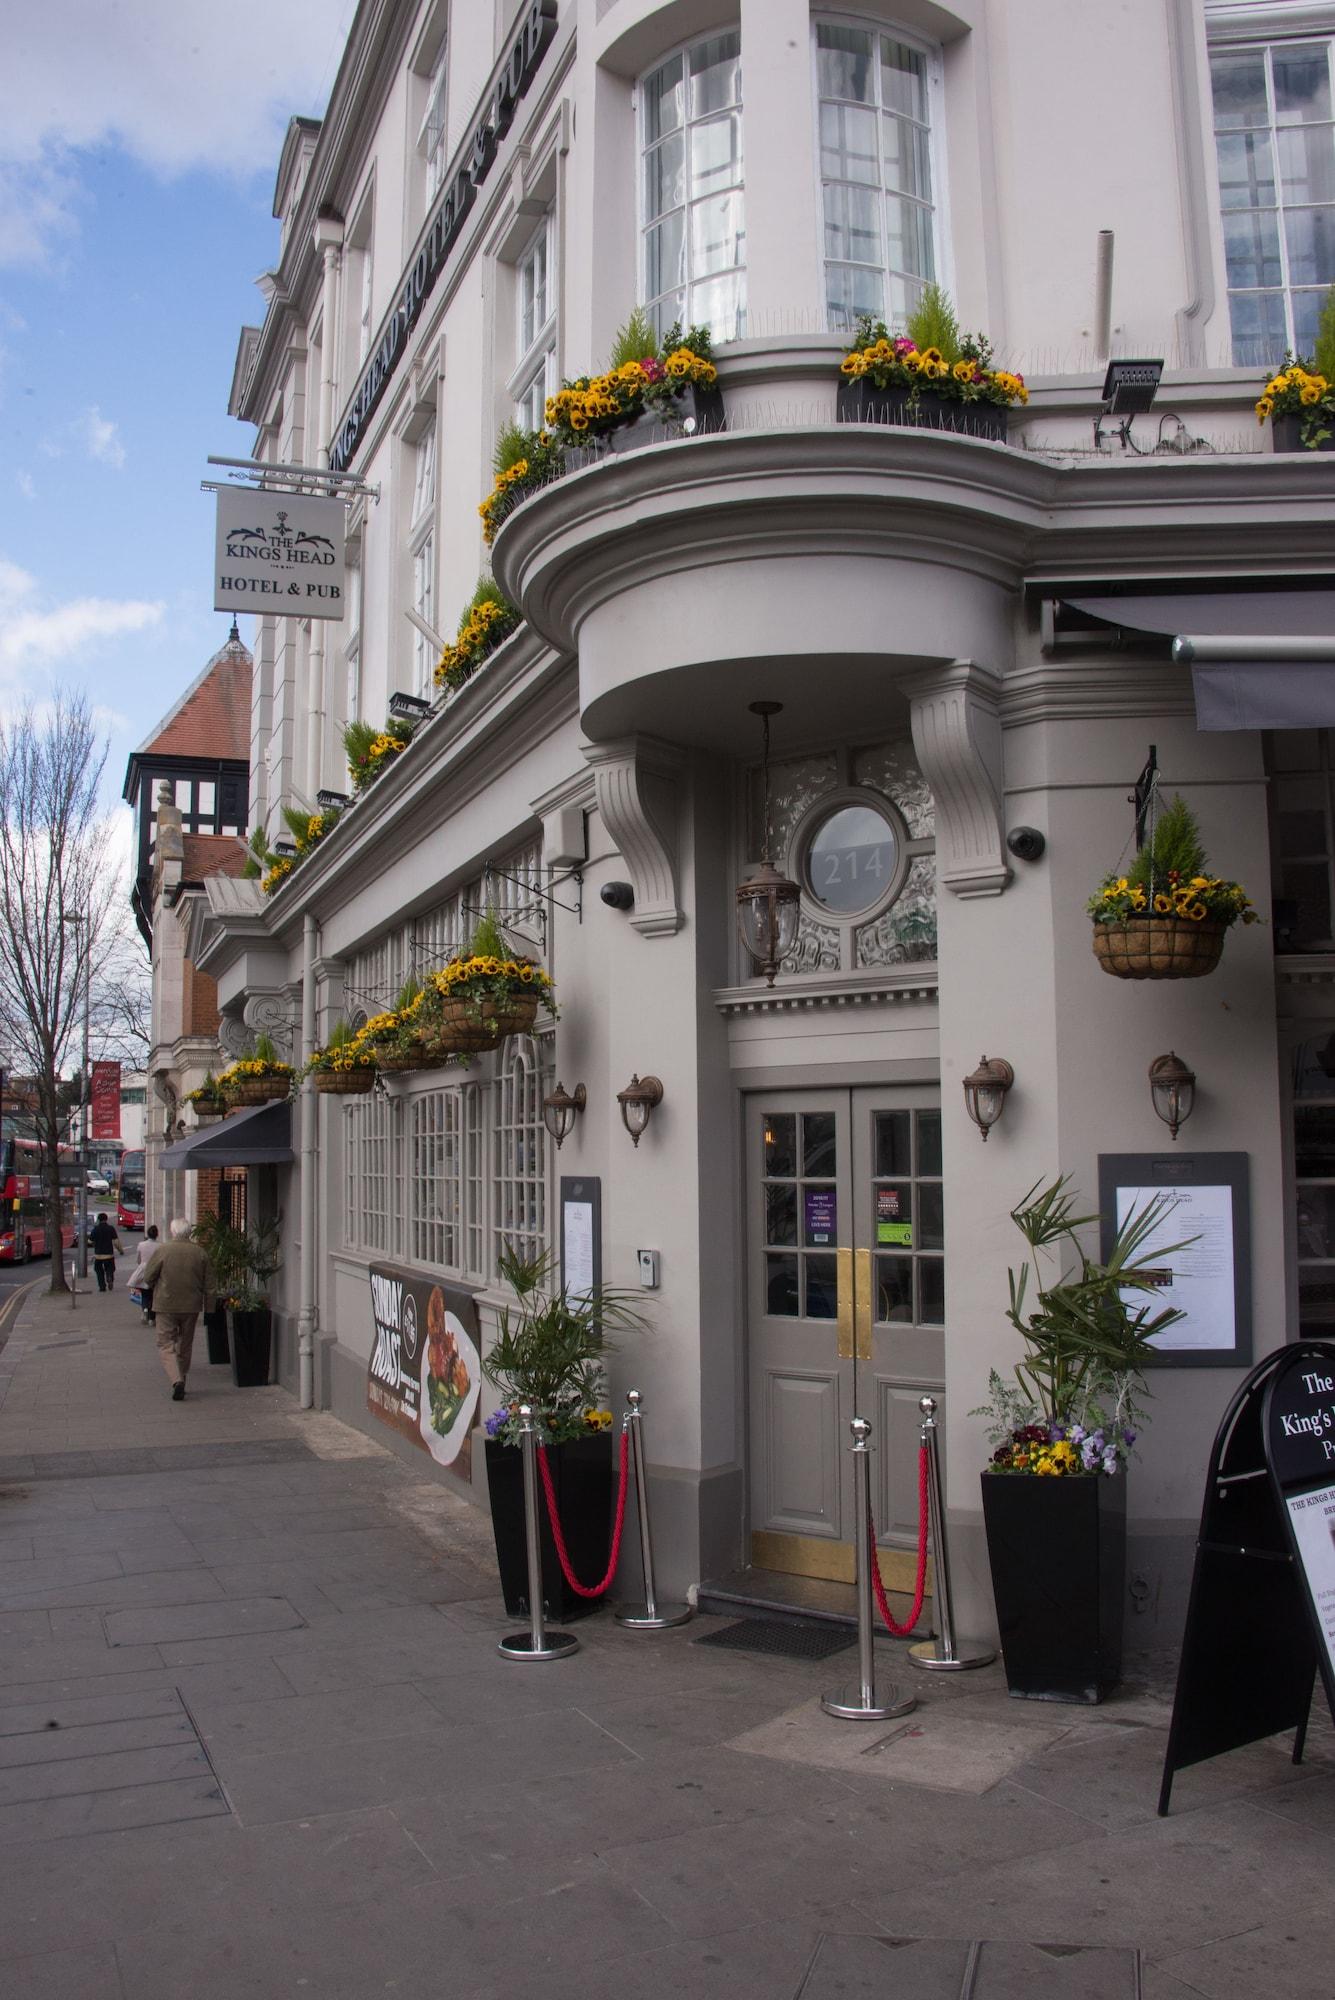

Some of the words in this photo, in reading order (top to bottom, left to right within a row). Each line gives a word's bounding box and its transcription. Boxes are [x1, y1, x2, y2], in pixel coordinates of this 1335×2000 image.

[360, 311, 399, 422] HEAD
[403, 171, 466, 333] HOTEL
[491, 0, 543, 138] PUB
[268, 536, 293, 549] THE
[226, 544, 281, 561] KINGS
[286, 549, 336, 566] HEAD
[220, 576, 283, 595] HOTEL
[287, 582, 301, 596] &
[306, 583, 341, 599] PUB
[824, 847, 883, 885] 214
[371, 1274, 403, 1331] SUNDAY
[1301, 1372, 1334, 1394] The
[1280, 1408, 1332, 1437] King's
[1322, 1440, 1335, 1460] P
[1291, 1500, 1306, 1511] THE
[1305, 1493, 1329, 1507] KINGS
